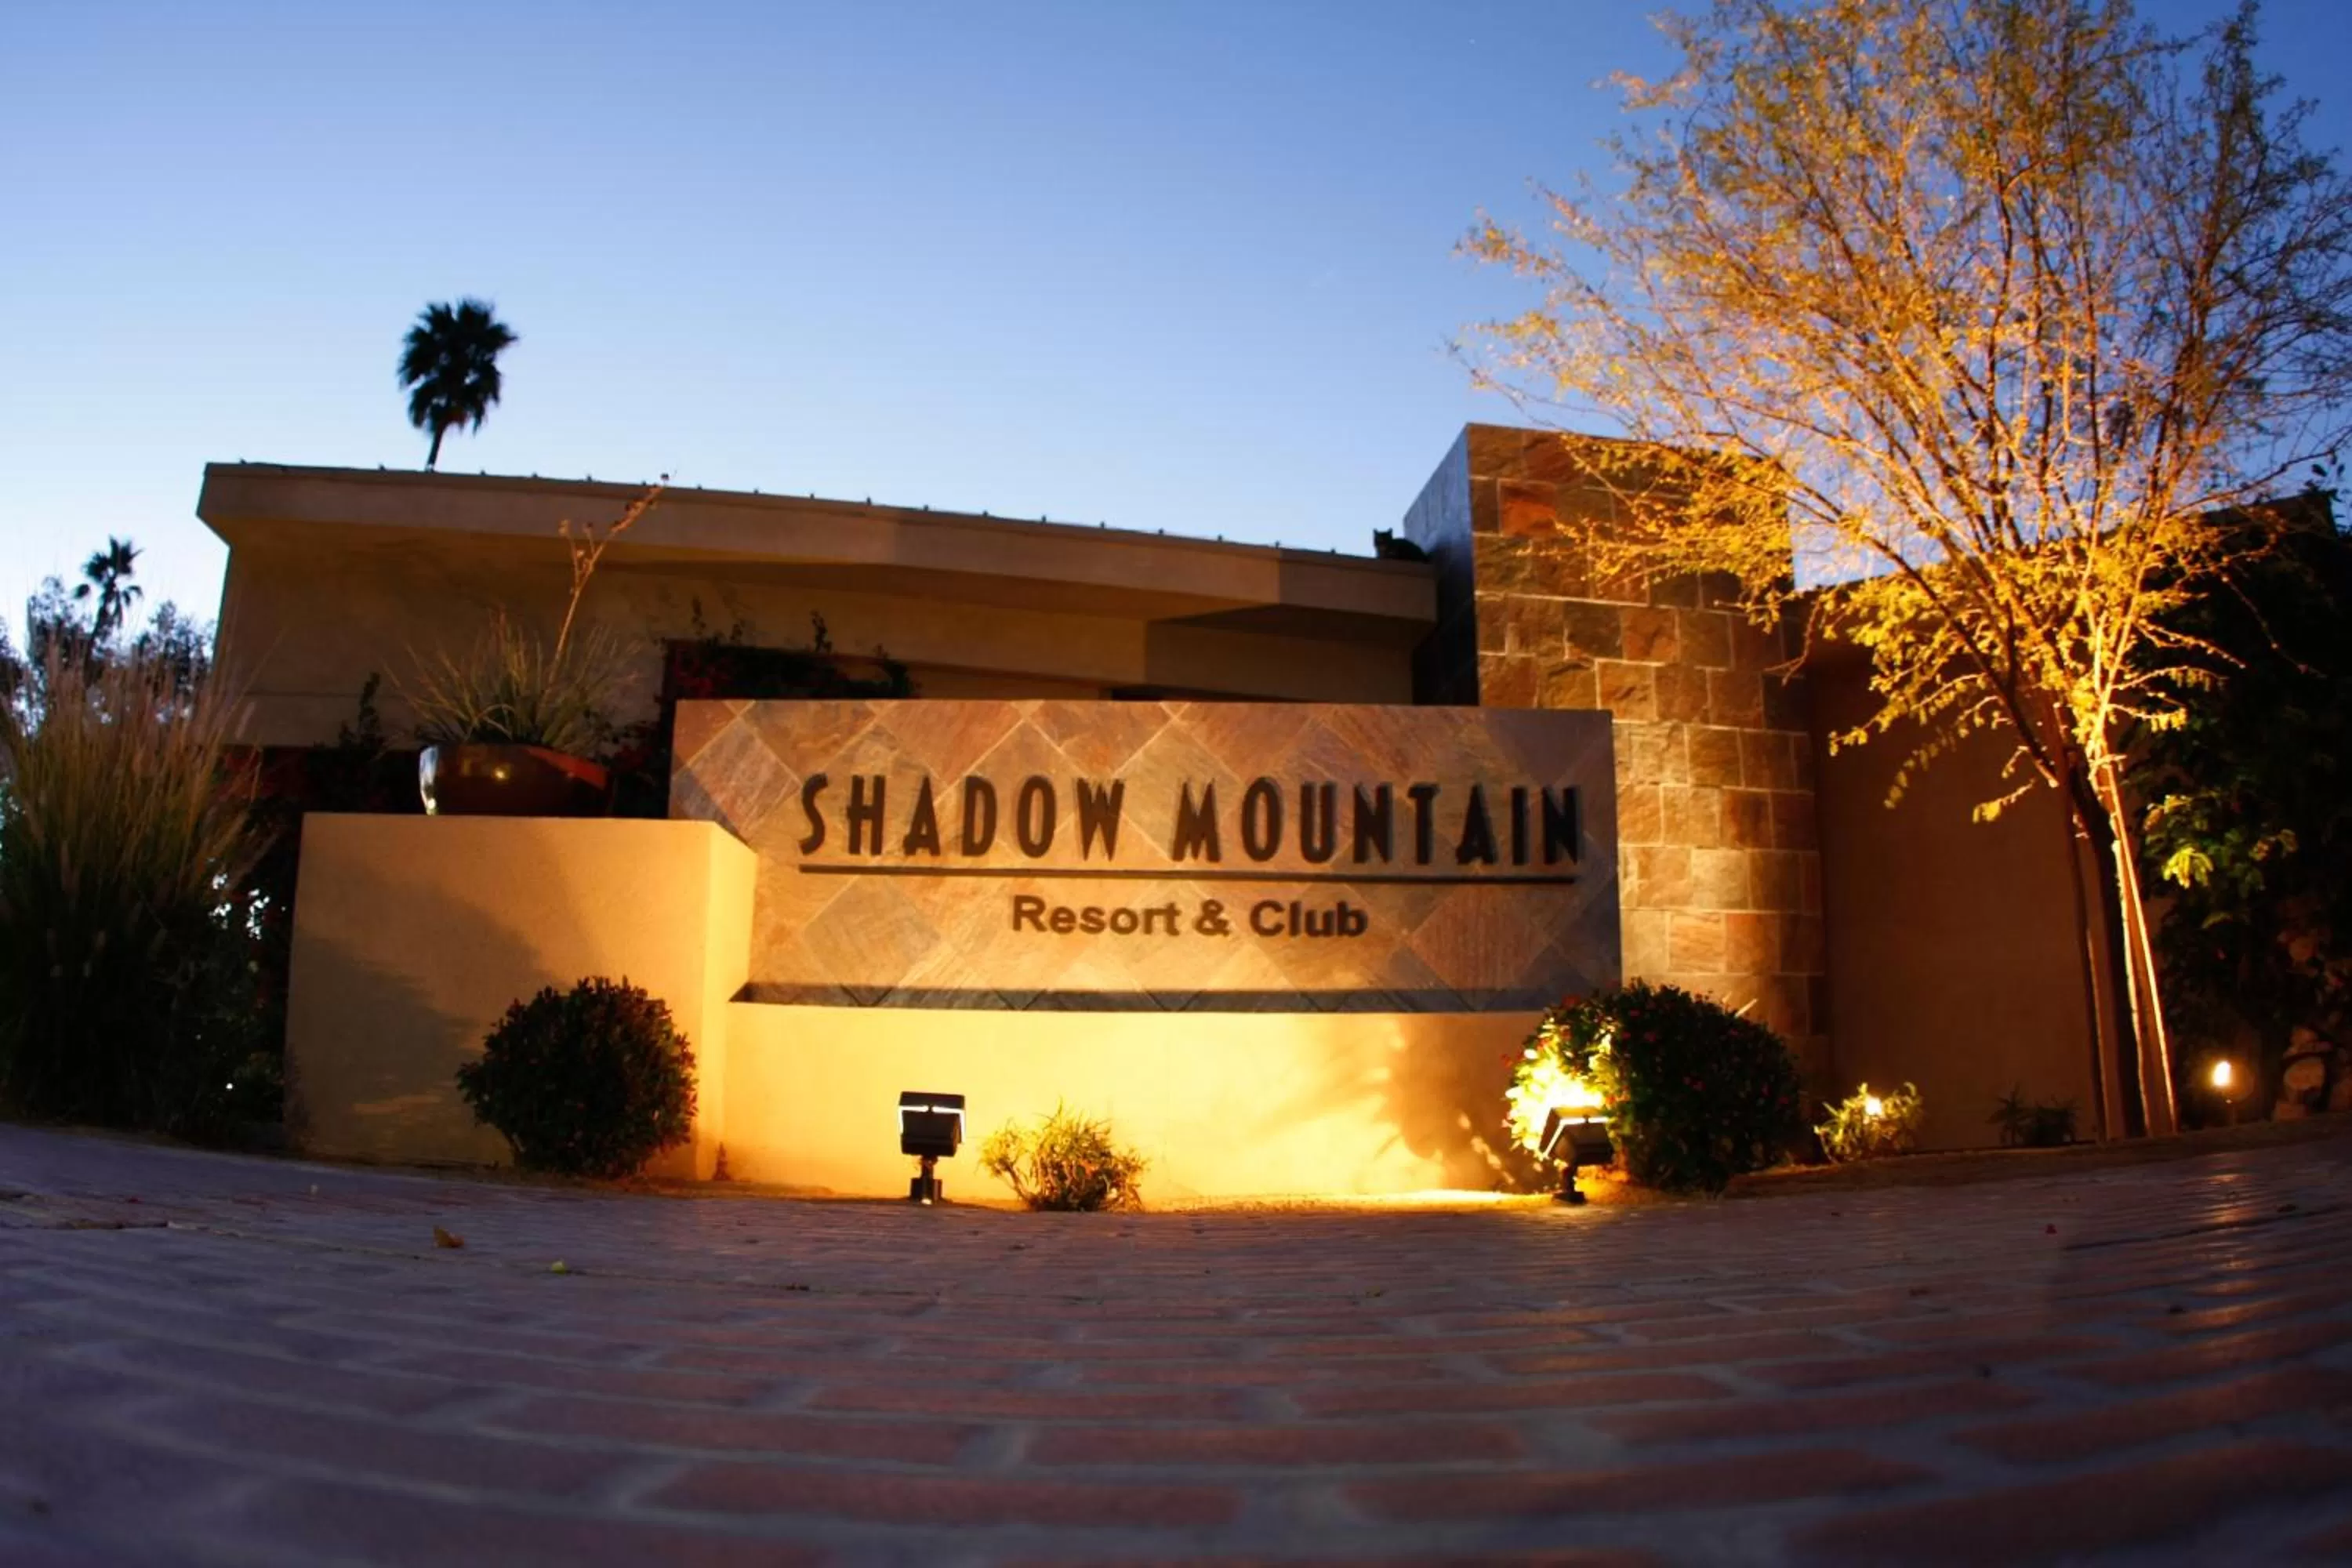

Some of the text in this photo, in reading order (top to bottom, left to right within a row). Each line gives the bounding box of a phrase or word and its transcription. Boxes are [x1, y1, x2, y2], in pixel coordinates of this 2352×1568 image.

[798, 772, 1581, 866] SHADOW MOUNTAIN
[1012, 895, 1368, 938] Resort & Club
